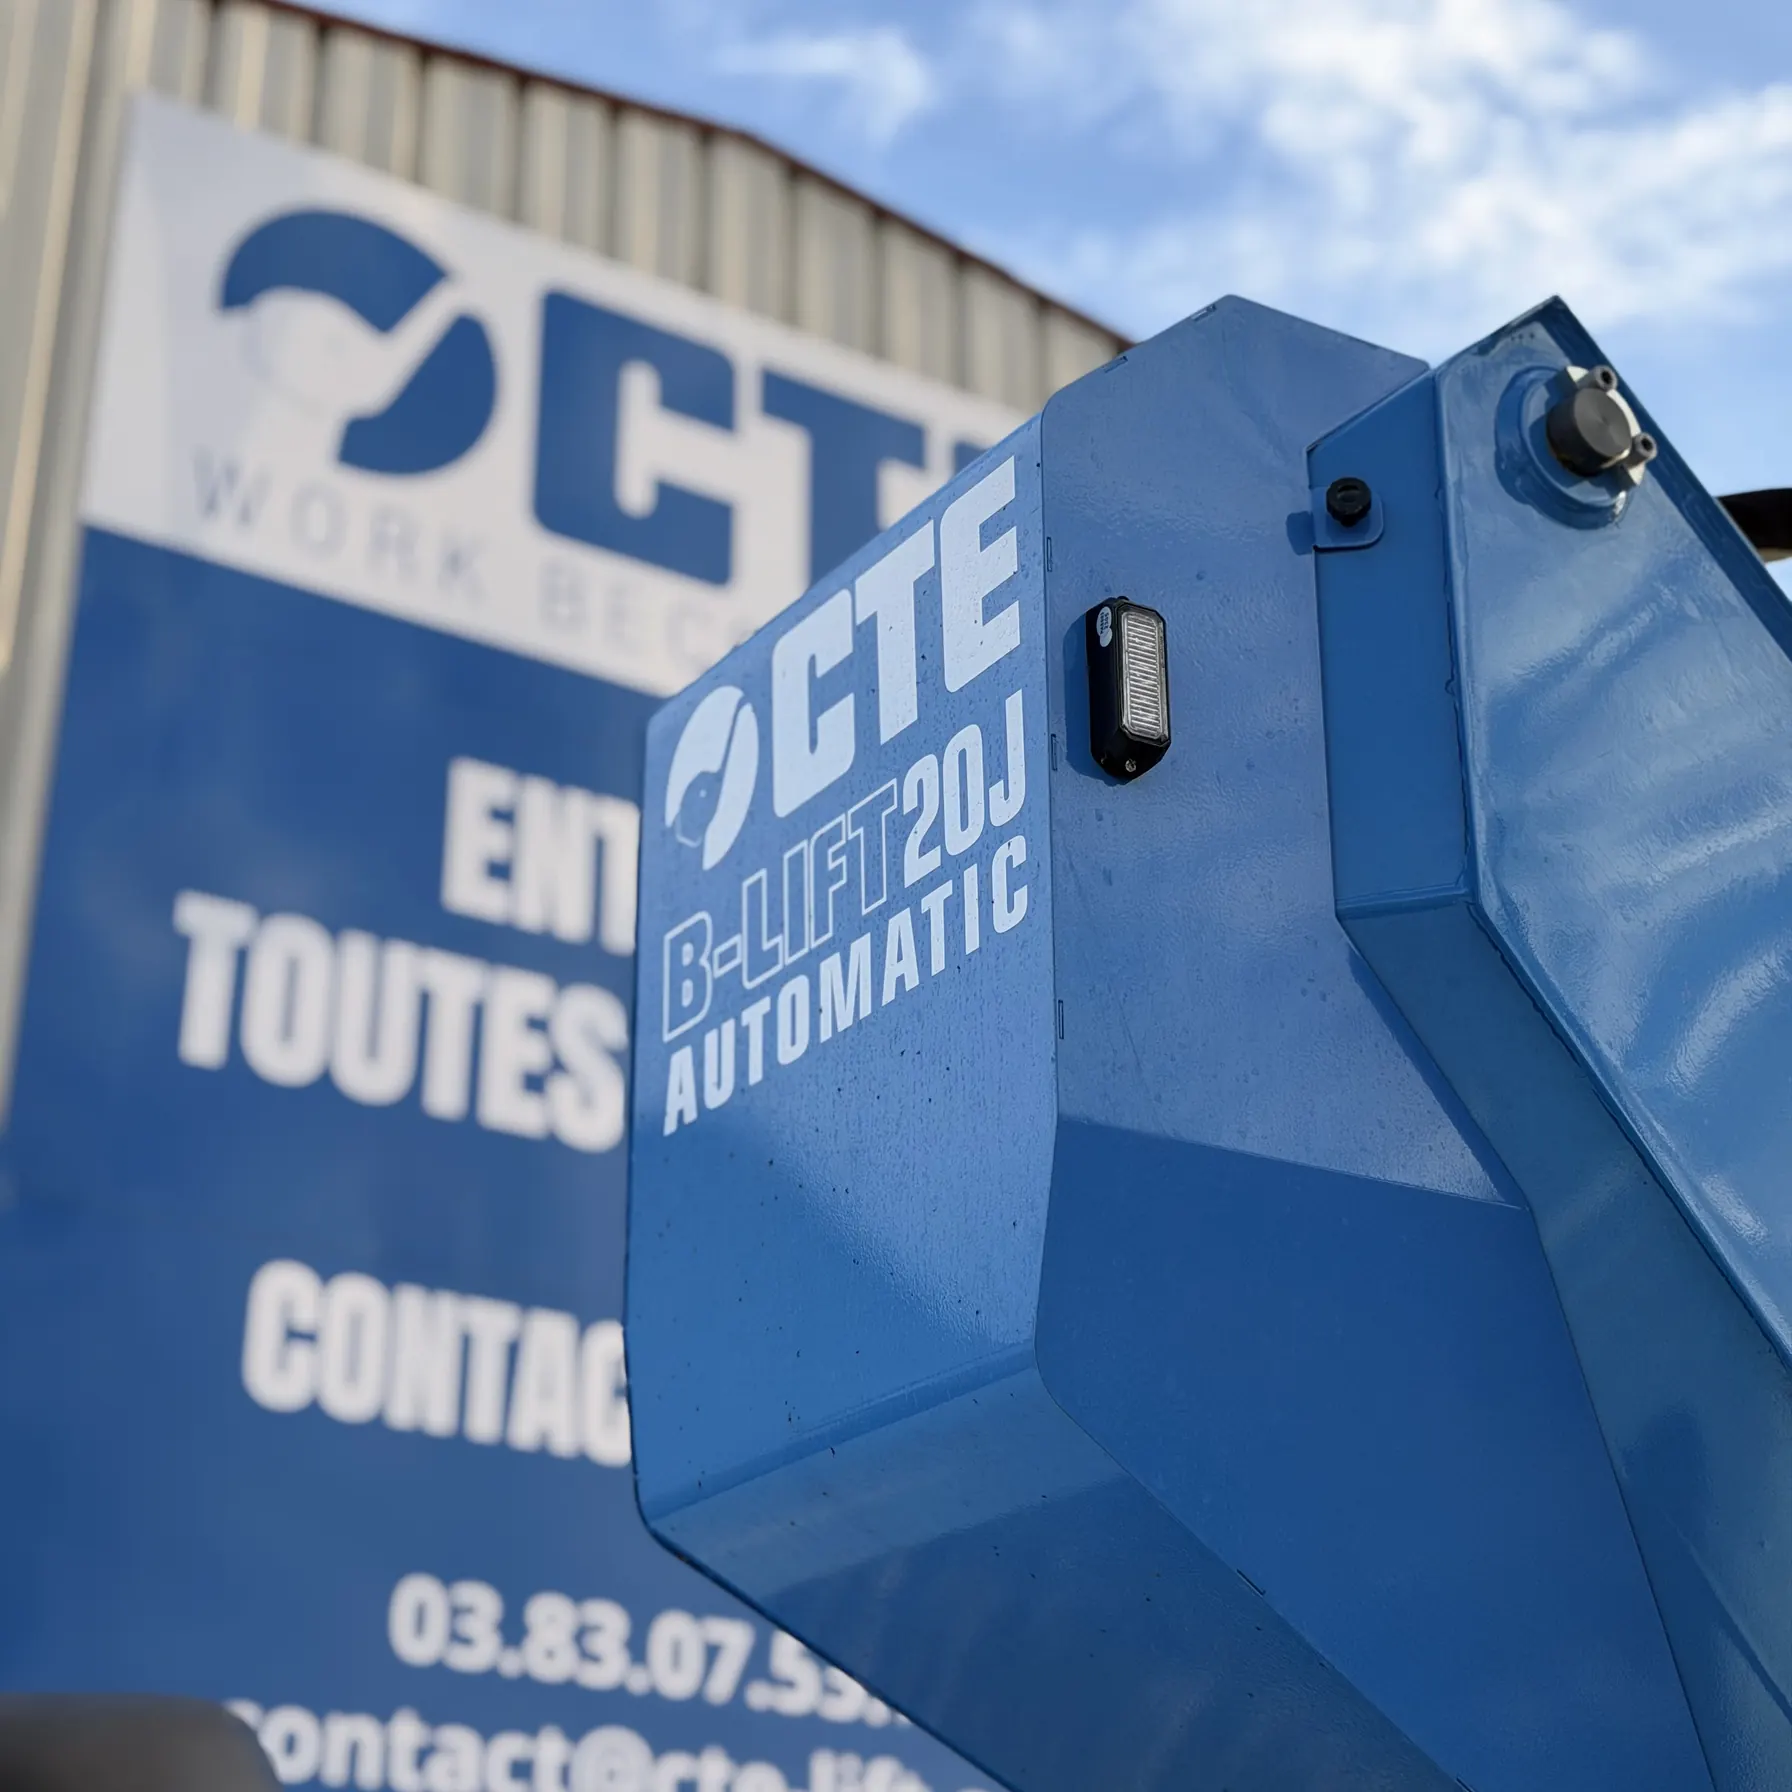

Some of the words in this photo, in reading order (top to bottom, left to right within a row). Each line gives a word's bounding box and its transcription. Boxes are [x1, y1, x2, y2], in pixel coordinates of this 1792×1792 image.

[189, 445, 490, 606] WORK
[538, 555, 754, 674] BEC
[534, 288, 990, 594] CT
[772, 456, 1021, 818] CTE
[172, 887, 629, 1153] TOUTES
[664, 835, 1028, 1136] AUTOMATIC
